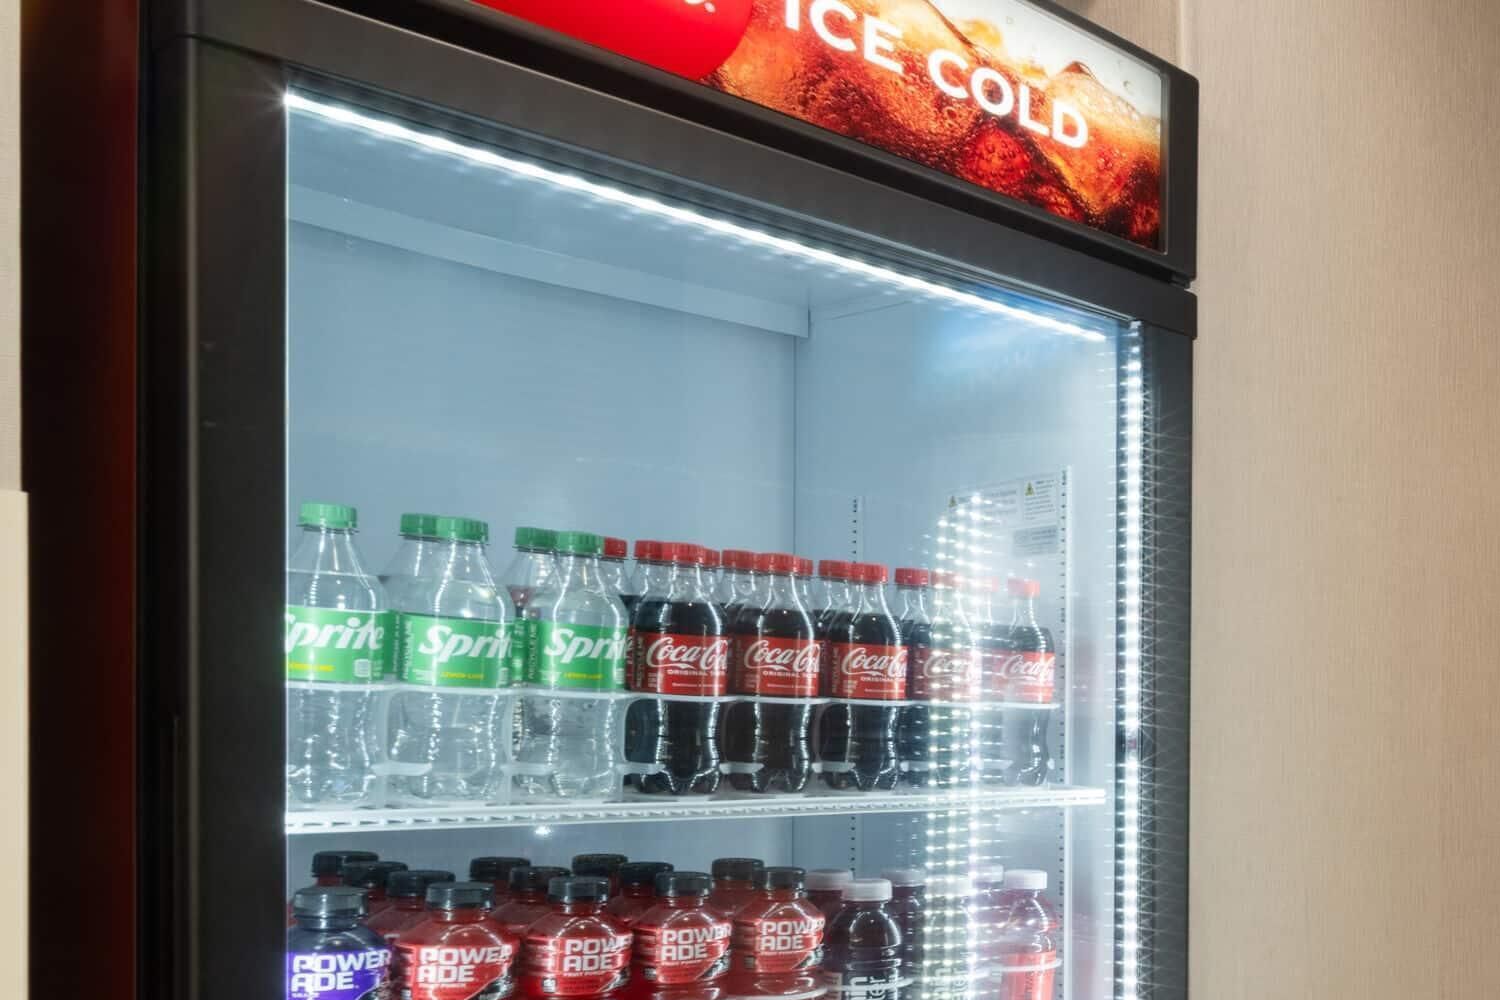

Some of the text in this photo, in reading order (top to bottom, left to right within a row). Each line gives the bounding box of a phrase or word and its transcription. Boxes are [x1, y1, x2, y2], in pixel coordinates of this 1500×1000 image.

[784, 0, 1089, 150] ICE COLD
[285, 613, 385, 655] prite
[418, 623, 513, 663] Sprit
[543, 628, 630, 664] Sprit
[662, 922, 732, 945] POWER
[760, 934, 802, 951] ADE
[292, 950, 392, 974] POWER
[419, 944, 513, 966] POWER
[562, 953, 614, 973] ADE
[660, 943, 708, 963] ADE
[290, 972, 354, 993] ADE
[417, 965, 475, 984] ADE
